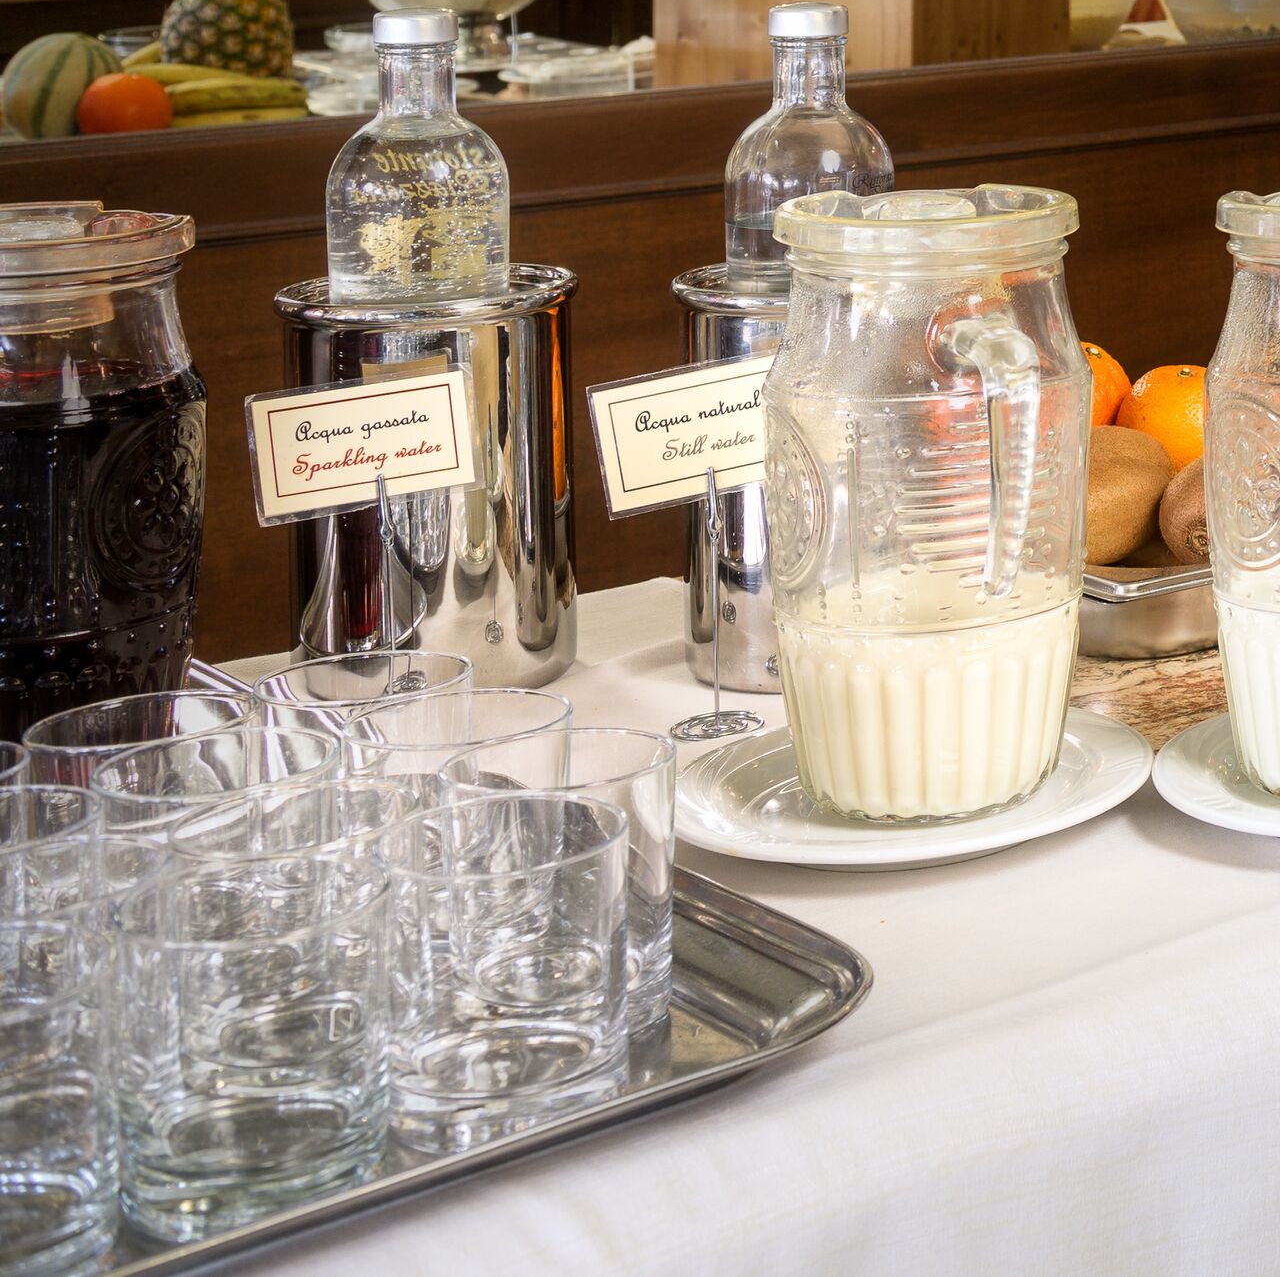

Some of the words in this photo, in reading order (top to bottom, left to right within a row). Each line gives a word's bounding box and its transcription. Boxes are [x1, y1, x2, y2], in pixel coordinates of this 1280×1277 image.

[295, 420, 354, 443] Acqua
[360, 409, 430, 439] gassata
[634, 410, 692, 433] Acqua
[698, 389, 761, 420] natural
[292, 446, 388, 482] Sparkling
[394, 440, 442, 458] water
[662, 433, 708, 461] Still
[710, 430, 756, 451] water
